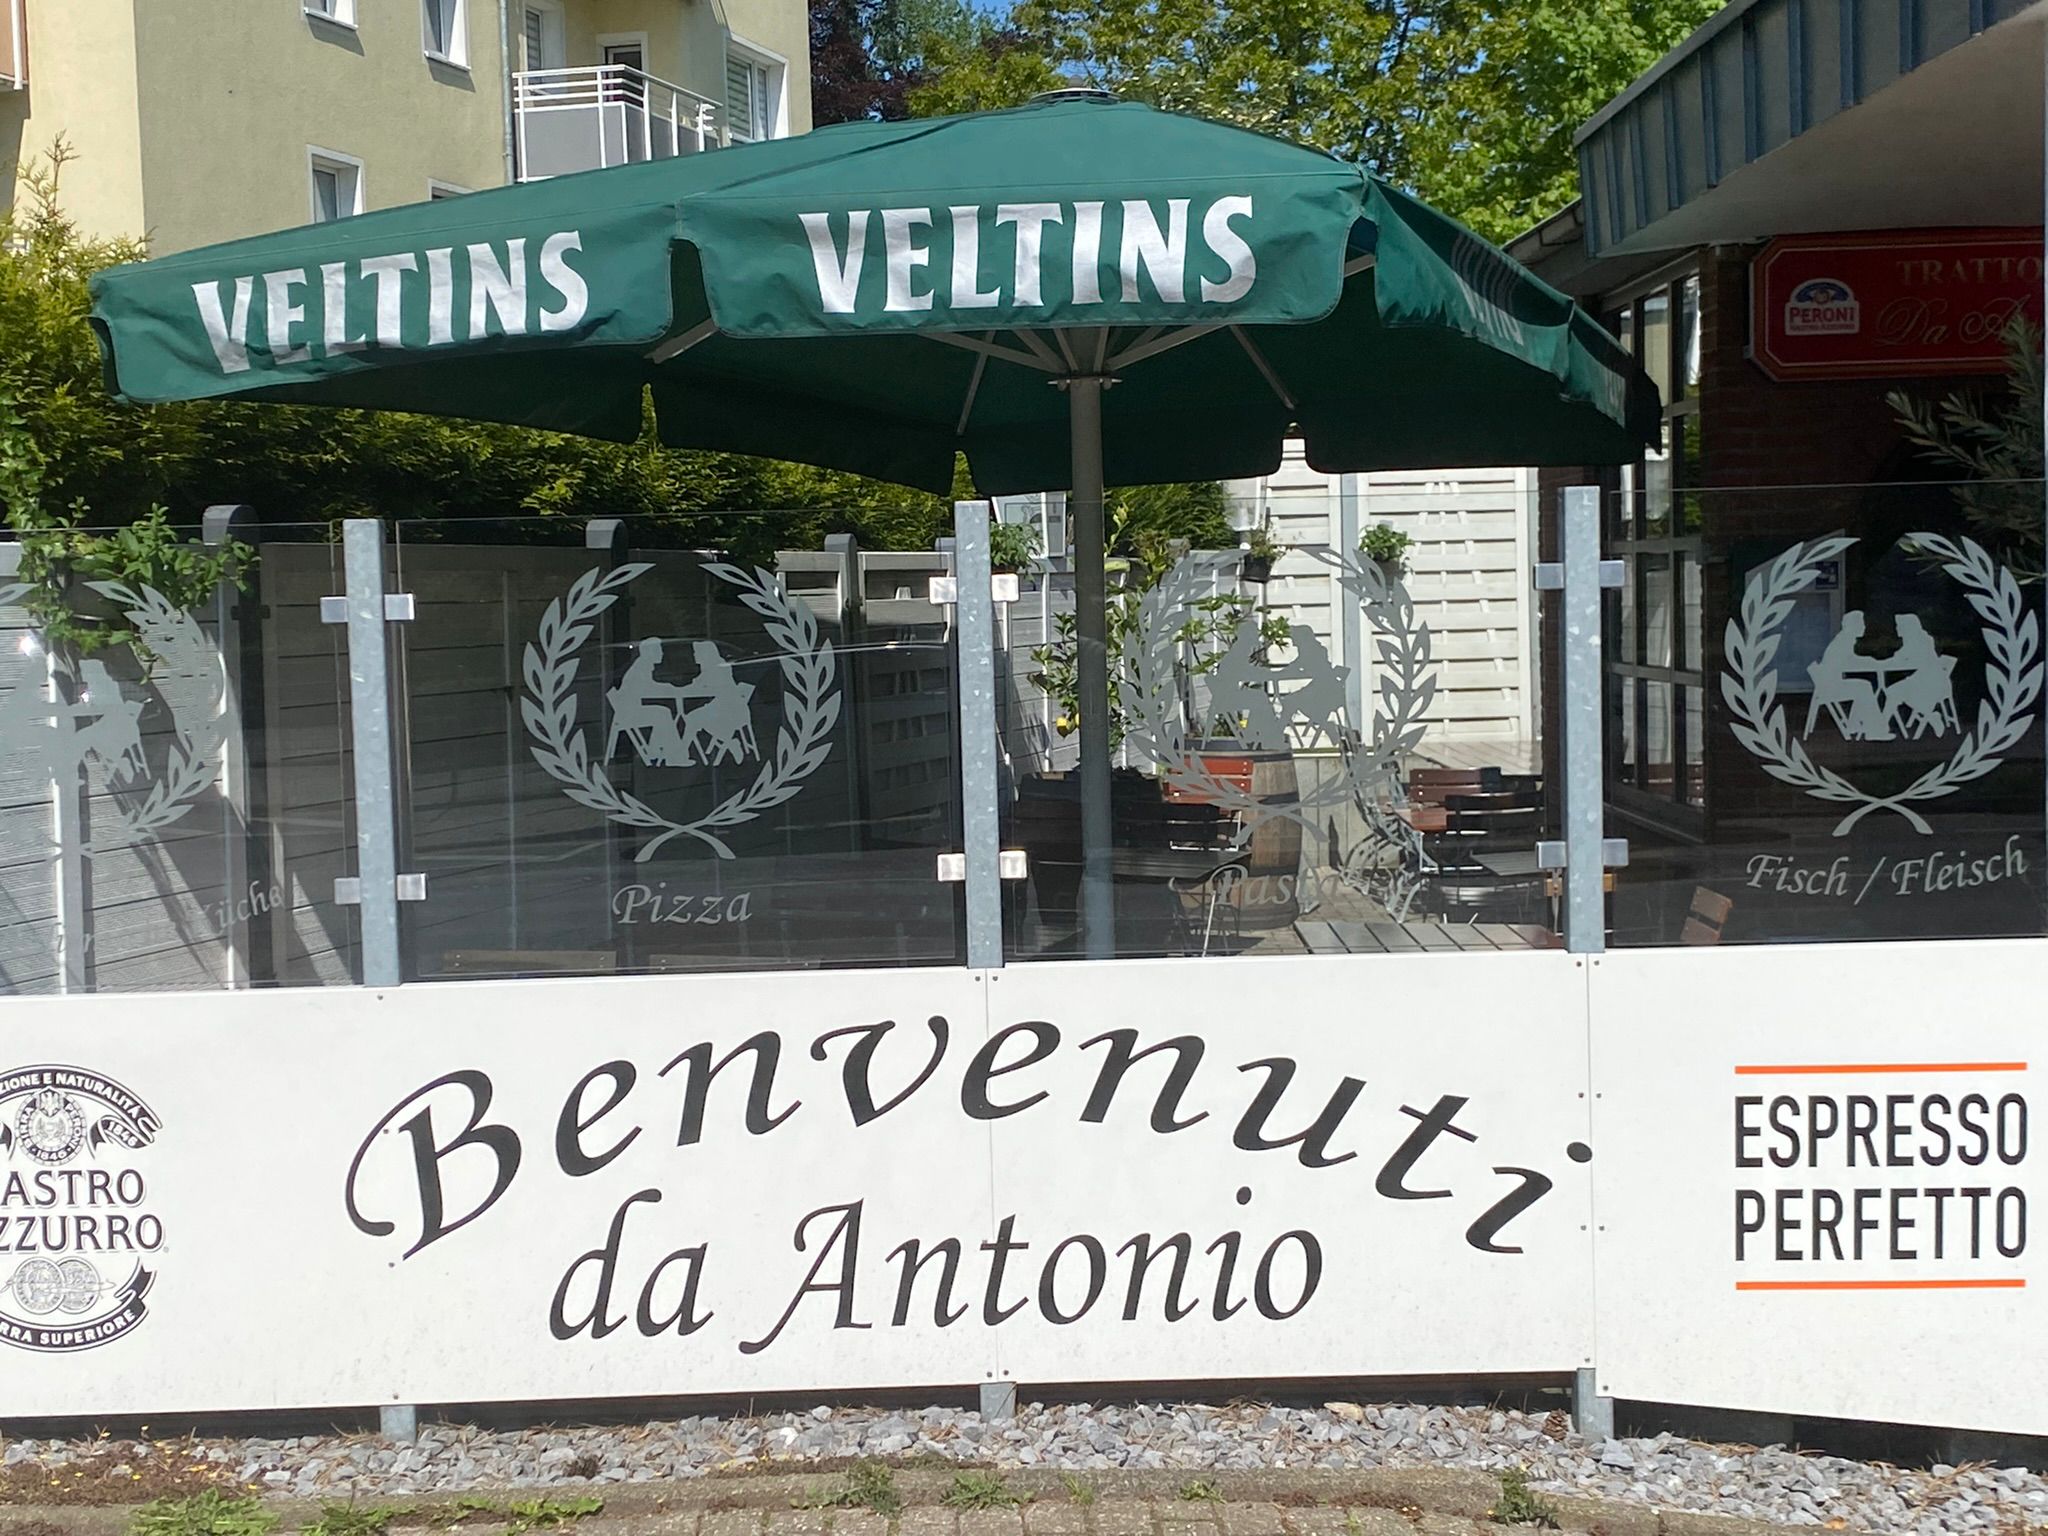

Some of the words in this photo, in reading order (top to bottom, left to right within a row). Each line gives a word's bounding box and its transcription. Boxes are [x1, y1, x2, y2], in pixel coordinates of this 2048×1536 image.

[798, 195, 1257, 314] VELTINS
[191, 230, 589, 374] VELTINS
[1789, 307, 1855, 323] PERONI
[1873, 296, 1950, 346] Da
[1746, 854, 1849, 896] Fisch
[1891, 834, 2028, 896] Fleisch
[612, 882, 752, 924] Pizza
[43, 1072, 52, 1084] E
[107, 1121, 138, 1147] 1846
[345, 1016, 1593, 1260] Benvenuti
[1735, 1093, 2027, 1168] ESPRESSO
[0, 1169, 145, 1206] ASTRO
[1735, 1186, 2027, 1261] PERFETTO
[549, 1188, 714, 1340] da
[738, 1186, 1323, 1355] Antonio
[39, 1309, 137, 1345] SUPERIORE
